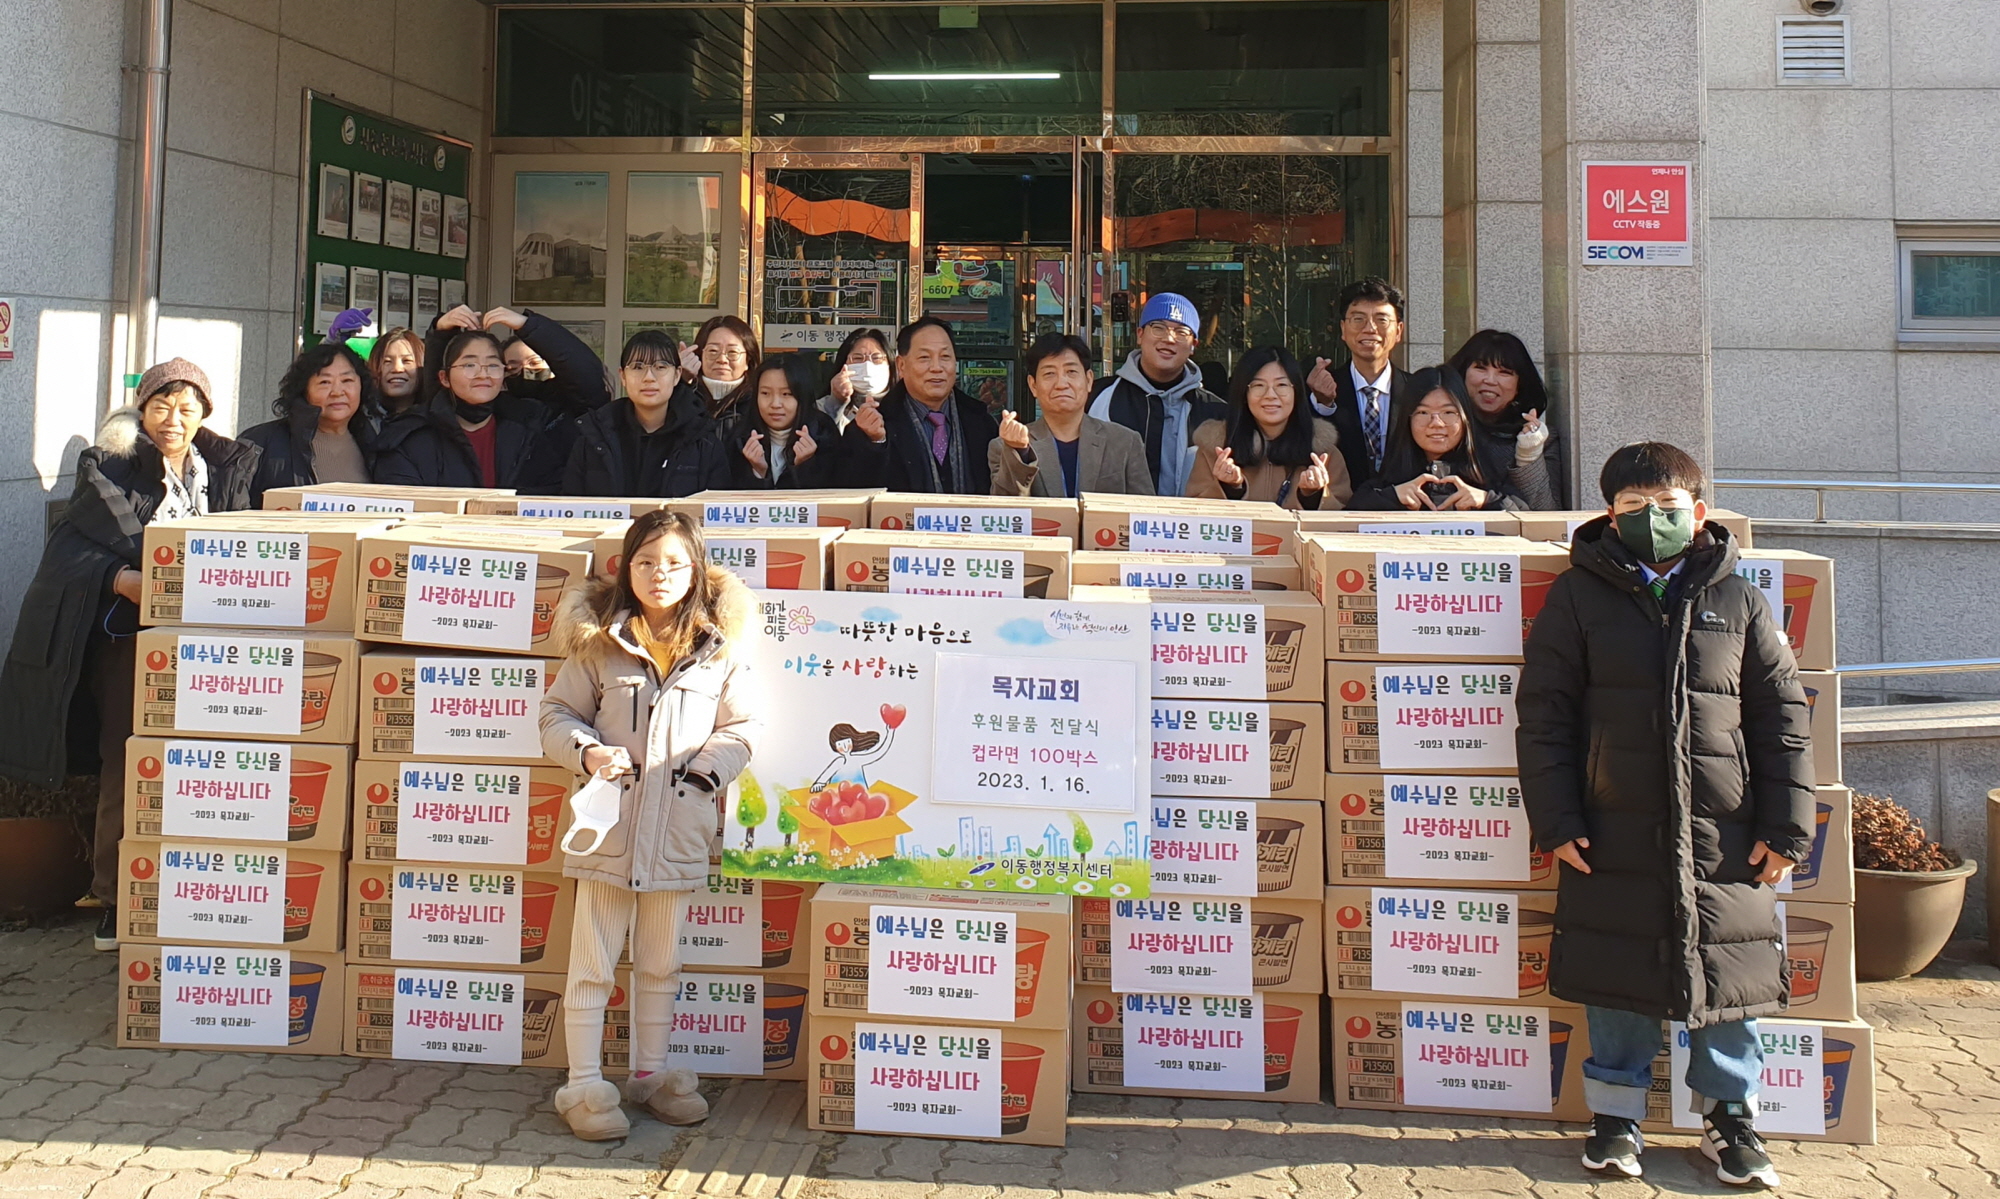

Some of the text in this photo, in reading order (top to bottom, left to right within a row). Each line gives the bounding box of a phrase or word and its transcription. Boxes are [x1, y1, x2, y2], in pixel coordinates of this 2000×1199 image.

[1602, 189, 1670, 214] 에스원
[1613, 220, 1661, 229] CCTV 작동중
[1588, 246, 1644, 259] SECOM
[797, 330, 819, 342] 이동
[706, 505, 809, 523] 예수님은 당신을
[982, 516, 1023, 533] 당신을
[1133, 521, 1243, 543] 예수님은 당신을
[191, 539, 301, 560] 예수님은 당신을
[412, 554, 527, 581] 예수님은 당신을
[893, 556, 1014, 579] 예수님은 당신을
[1383, 562, 1512, 583] 예수님은 당신을
[199, 569, 291, 588] 사랑하십니다
[419, 586, 515, 608] 사랑하십니다
[1395, 594, 1503, 614] 사랑하십니다
[767, 614, 787, 624] 피는
[1151, 612, 1257, 634] 수님은 당신을
[764, 625, 790, 642] 이동
[840, 621, 972, 645] 따뜻한 마음으로
[181, 644, 294, 666] 예수님은 당신을
[784, 653, 919, 680] 이웃을 사랑하는
[189, 675, 284, 695] 사랑하십니다
[421, 667, 538, 688] 예수님은 당신을
[1383, 674, 1513, 695] 예수님은 당신을
[992, 675, 1080, 702] 목자교회
[430, 698, 528, 717] 사랑하십니다
[1396, 707, 1504, 727] 사랑하십니다
[388, 714, 413, 725] 가3556
[971, 712, 1099, 737] 후원물품 전달식
[1151, 709, 1259, 732] 수님은 당신을
[168, 749, 281, 771] 예수님은 당신을
[972, 744, 1099, 768] 컵라면 100박스
[176, 780, 271, 800] 사랑하십니다
[404, 771, 521, 794] 예수님은 당신을
[977, 772, 1090, 794] 2023. 1. 16.
[1391, 785, 1520, 808] 예수님은 당신을
[413, 803, 510, 823] 사랑하십니다
[1151, 807, 1249, 831] 님은 당신을
[1403, 818, 1511, 839] 사랑하십니다
[1151, 840, 1239, 862] 랑하십니다
[166, 851, 279, 875] 예수님은 당신을
[1001, 859, 1114, 879] 이동행정복지센터
[174, 882, 269, 903] 사랑하십니다
[399, 871, 515, 895] 예수님은 당신을
[408, 903, 505, 924] 사랑하십니다
[686, 905, 744, 925] 십니다
[1117, 900, 1243, 923] 예수님은 당신을
[1379, 897, 1510, 924] 예수님은 당신을
[876, 916, 1008, 943] 예수님은 당신을
[1128, 933, 1233, 954] 사랑하십니다
[1390, 931, 1499, 954] 사랑하십니다
[167, 956, 282, 977] 예수님은 당신을
[887, 951, 997, 975] 사랑하십니다
[176, 986, 272, 1006] 사랑하십니다
[398, 978, 458, 999] 예수님은
[469, 982, 514, 1003] 당신을
[709, 983, 756, 1003] 당신을
[1127, 994, 1253, 1019] 예수님은 당신을
[407, 1010, 504, 1031] 사랑하십니다
[671, 1013, 746, 1033] 하십니다
[1376, 1021, 1402, 1040] 농
[1406, 1011, 1539, 1037] 예수님은 당신을
[668, 1044, 688, 1053] 2023
[859, 1032, 991, 1059] 예수님은 당신을
[1138, 1027, 1243, 1049] 사랑하십니다
[1419, 1044, 1529, 1067] 사랑하십니다
[1364, 1062, 1393, 1072] 가3560
[870, 1067, 980, 1091] 사랑하십니다
[1758, 1101, 1786, 1111] 교회-
